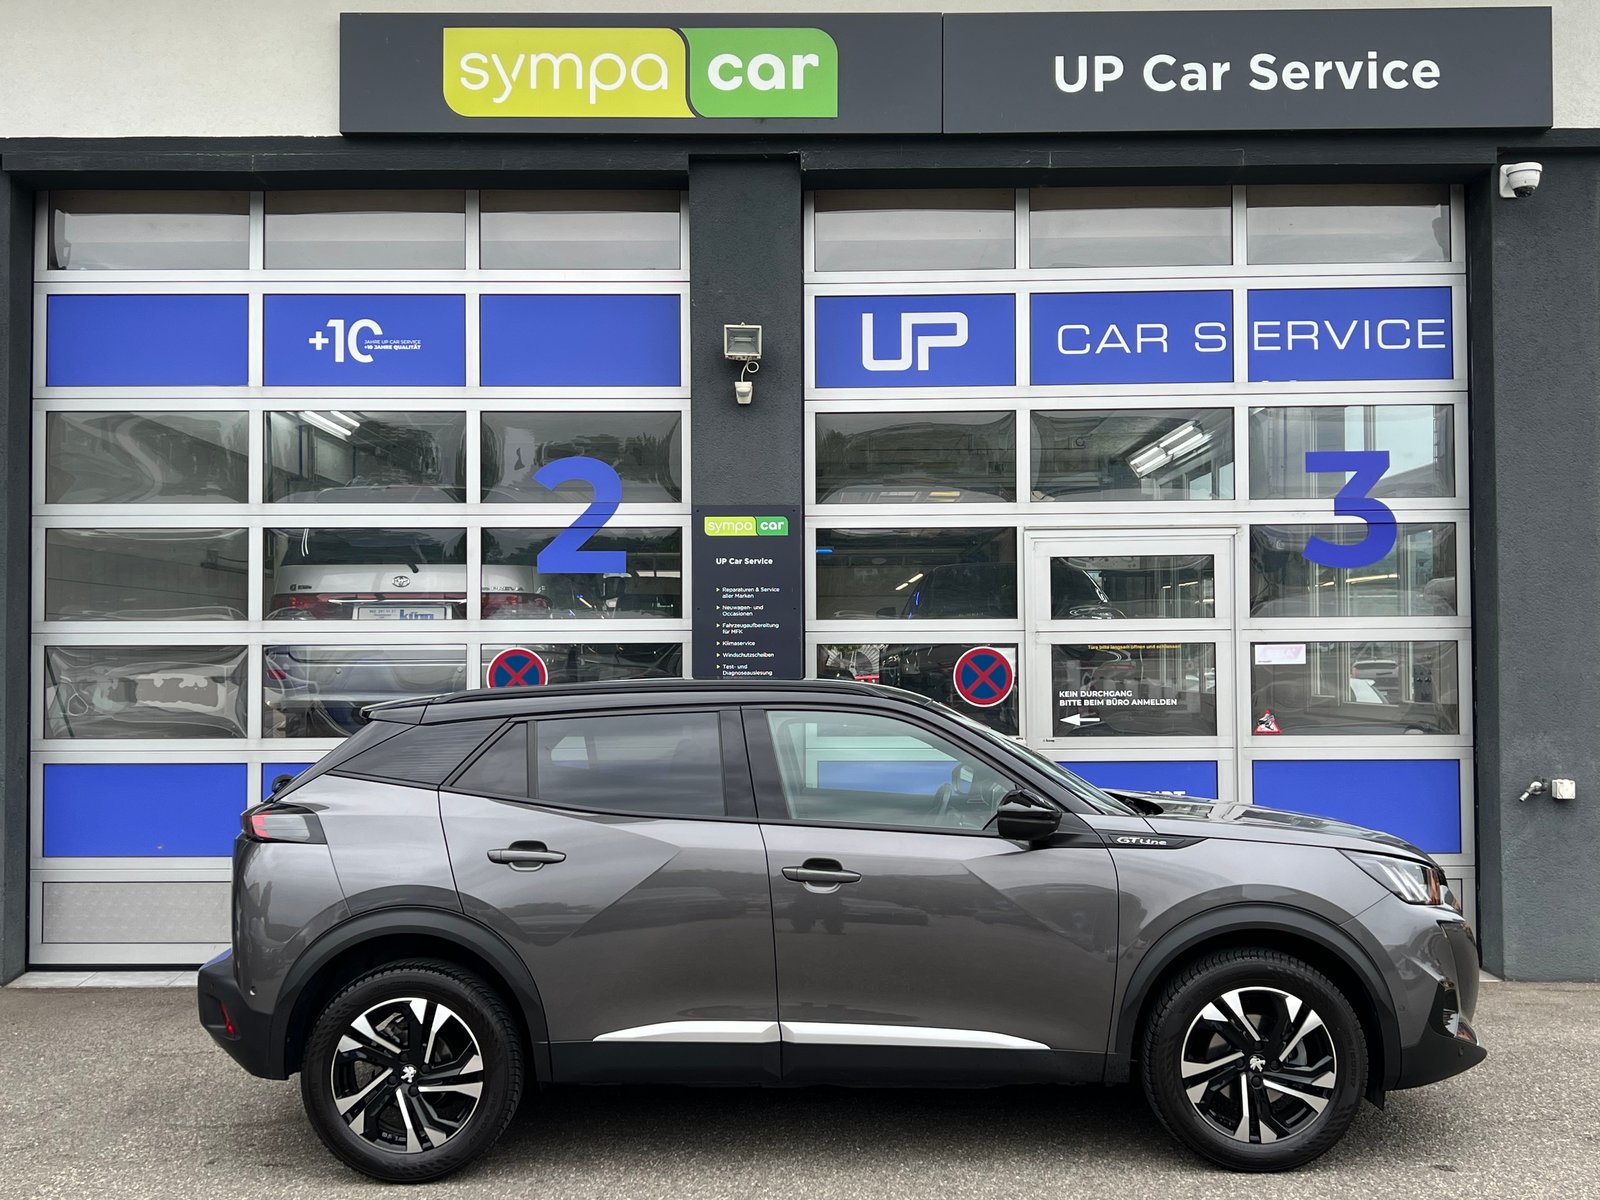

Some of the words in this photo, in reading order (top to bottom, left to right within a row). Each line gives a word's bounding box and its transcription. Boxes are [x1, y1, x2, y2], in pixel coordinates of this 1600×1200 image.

[459, 52, 669, 105] sympa
[708, 52, 820, 92] car
[1054, 54, 1124, 94] UP
[1143, 53, 1230, 92] Car
[1249, 50, 1441, 91] Service
[861, 312, 969, 372] UP
[1057, 323, 1168, 356] CAR
[533, 456, 627, 575] 2
[708, 521, 753, 533] sympa
[760, 521, 784, 531] car
[1302, 450, 1398, 569] 3
[744, 557, 773, 565] Service
[1059, 690, 1078, 698] KEIN
[1080, 690, 1133, 698] DURCHGANG
[1105, 698, 1129, 706] BÜRO
[1131, 698, 1178, 706] ANMELDEN
